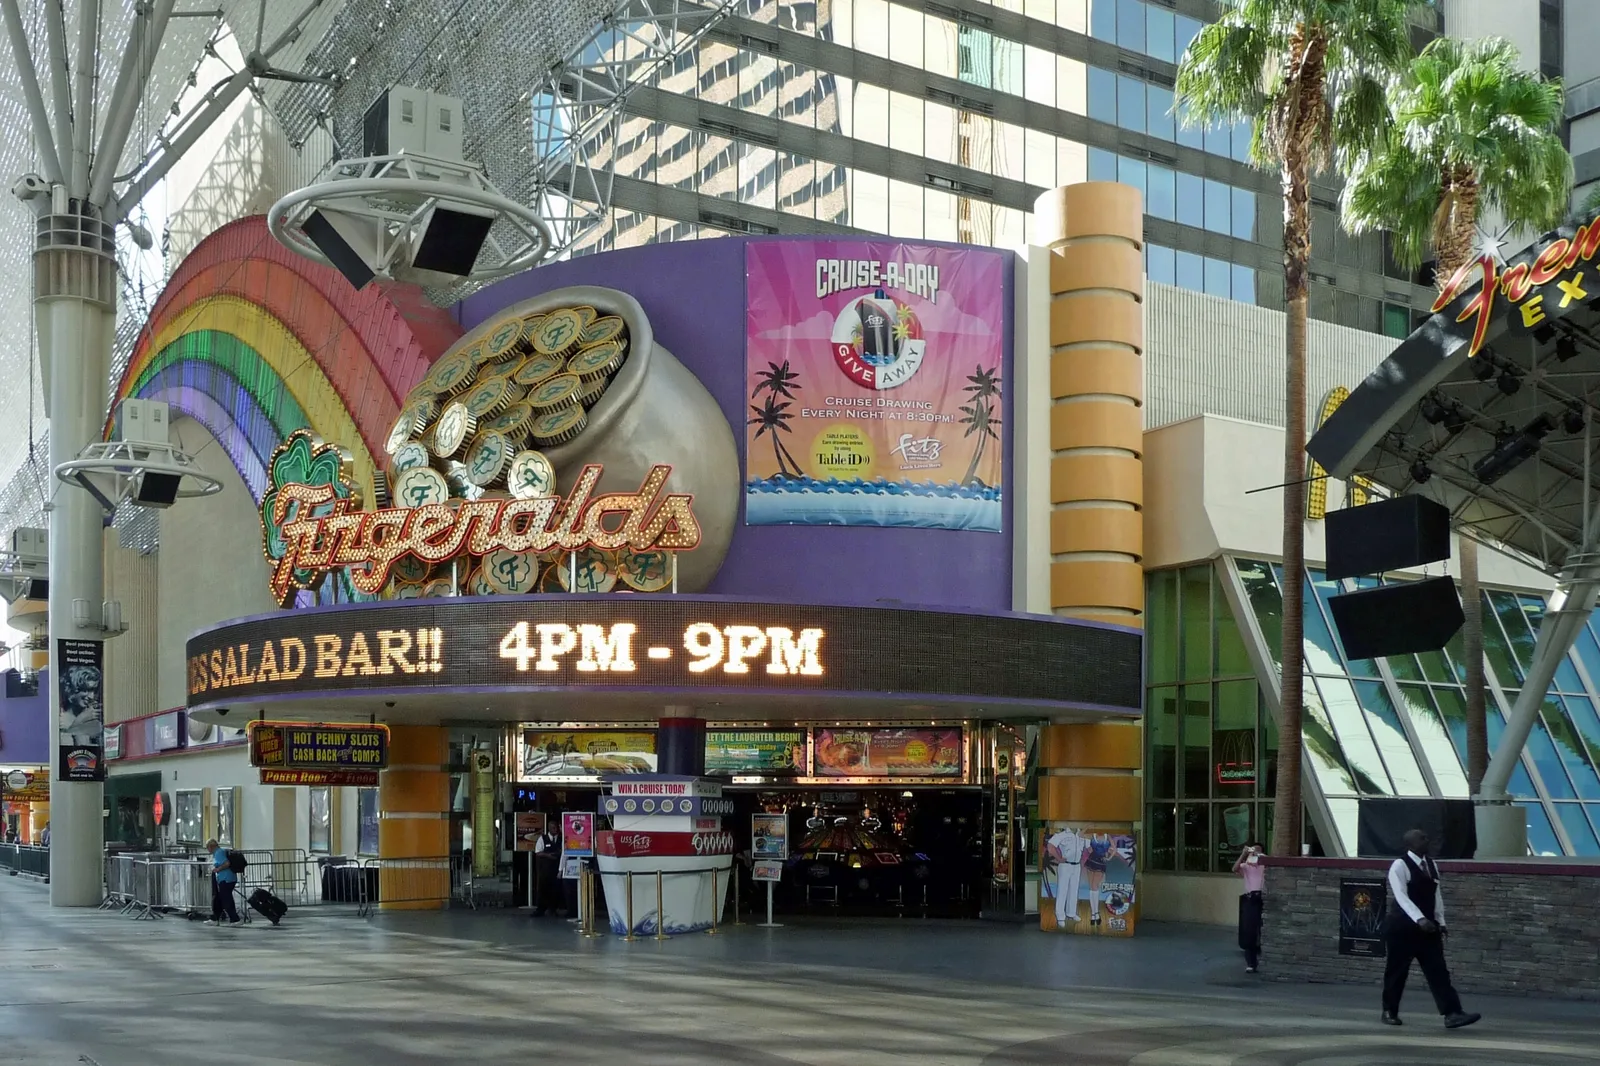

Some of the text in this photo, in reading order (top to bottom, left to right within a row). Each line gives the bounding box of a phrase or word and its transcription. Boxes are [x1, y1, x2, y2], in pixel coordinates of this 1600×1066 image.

[816, 259, 939, 304] CRUISE-A-DAY
[1519, 263, 1600, 328] EX
[838, 344, 875, 382] GIVE
[882, 347, 919, 384] AWAY
[825, 397, 933, 409] CRUISE DRAWING
[801, 408, 955, 423] EVERY NIGHT AT 8:30PM!
[890, 433, 947, 464] fitz
[816, 453, 847, 465] Table
[499, 621, 825, 675] 4PM - 9PM
[210, 636, 306, 689] SALAD
[313, 626, 443, 678] BAR!!
[293, 732, 379, 746] HOT PENNY SLOTS
[707, 732, 719, 741] LET
[720, 732, 734, 741] THE
[735, 732, 774, 741] LAUGHTER
[292, 748, 314, 761] CASH
[316, 748, 337, 761] BACK
[352, 749, 380, 763] COMPS
[265, 771, 297, 782] POKER
[300, 772, 327, 782] ROOM
[618, 783, 632, 794] WIN
[633, 784, 639, 794] A
[639, 783, 663, 794] CRUISE
[664, 784, 686, 794] TODAY
